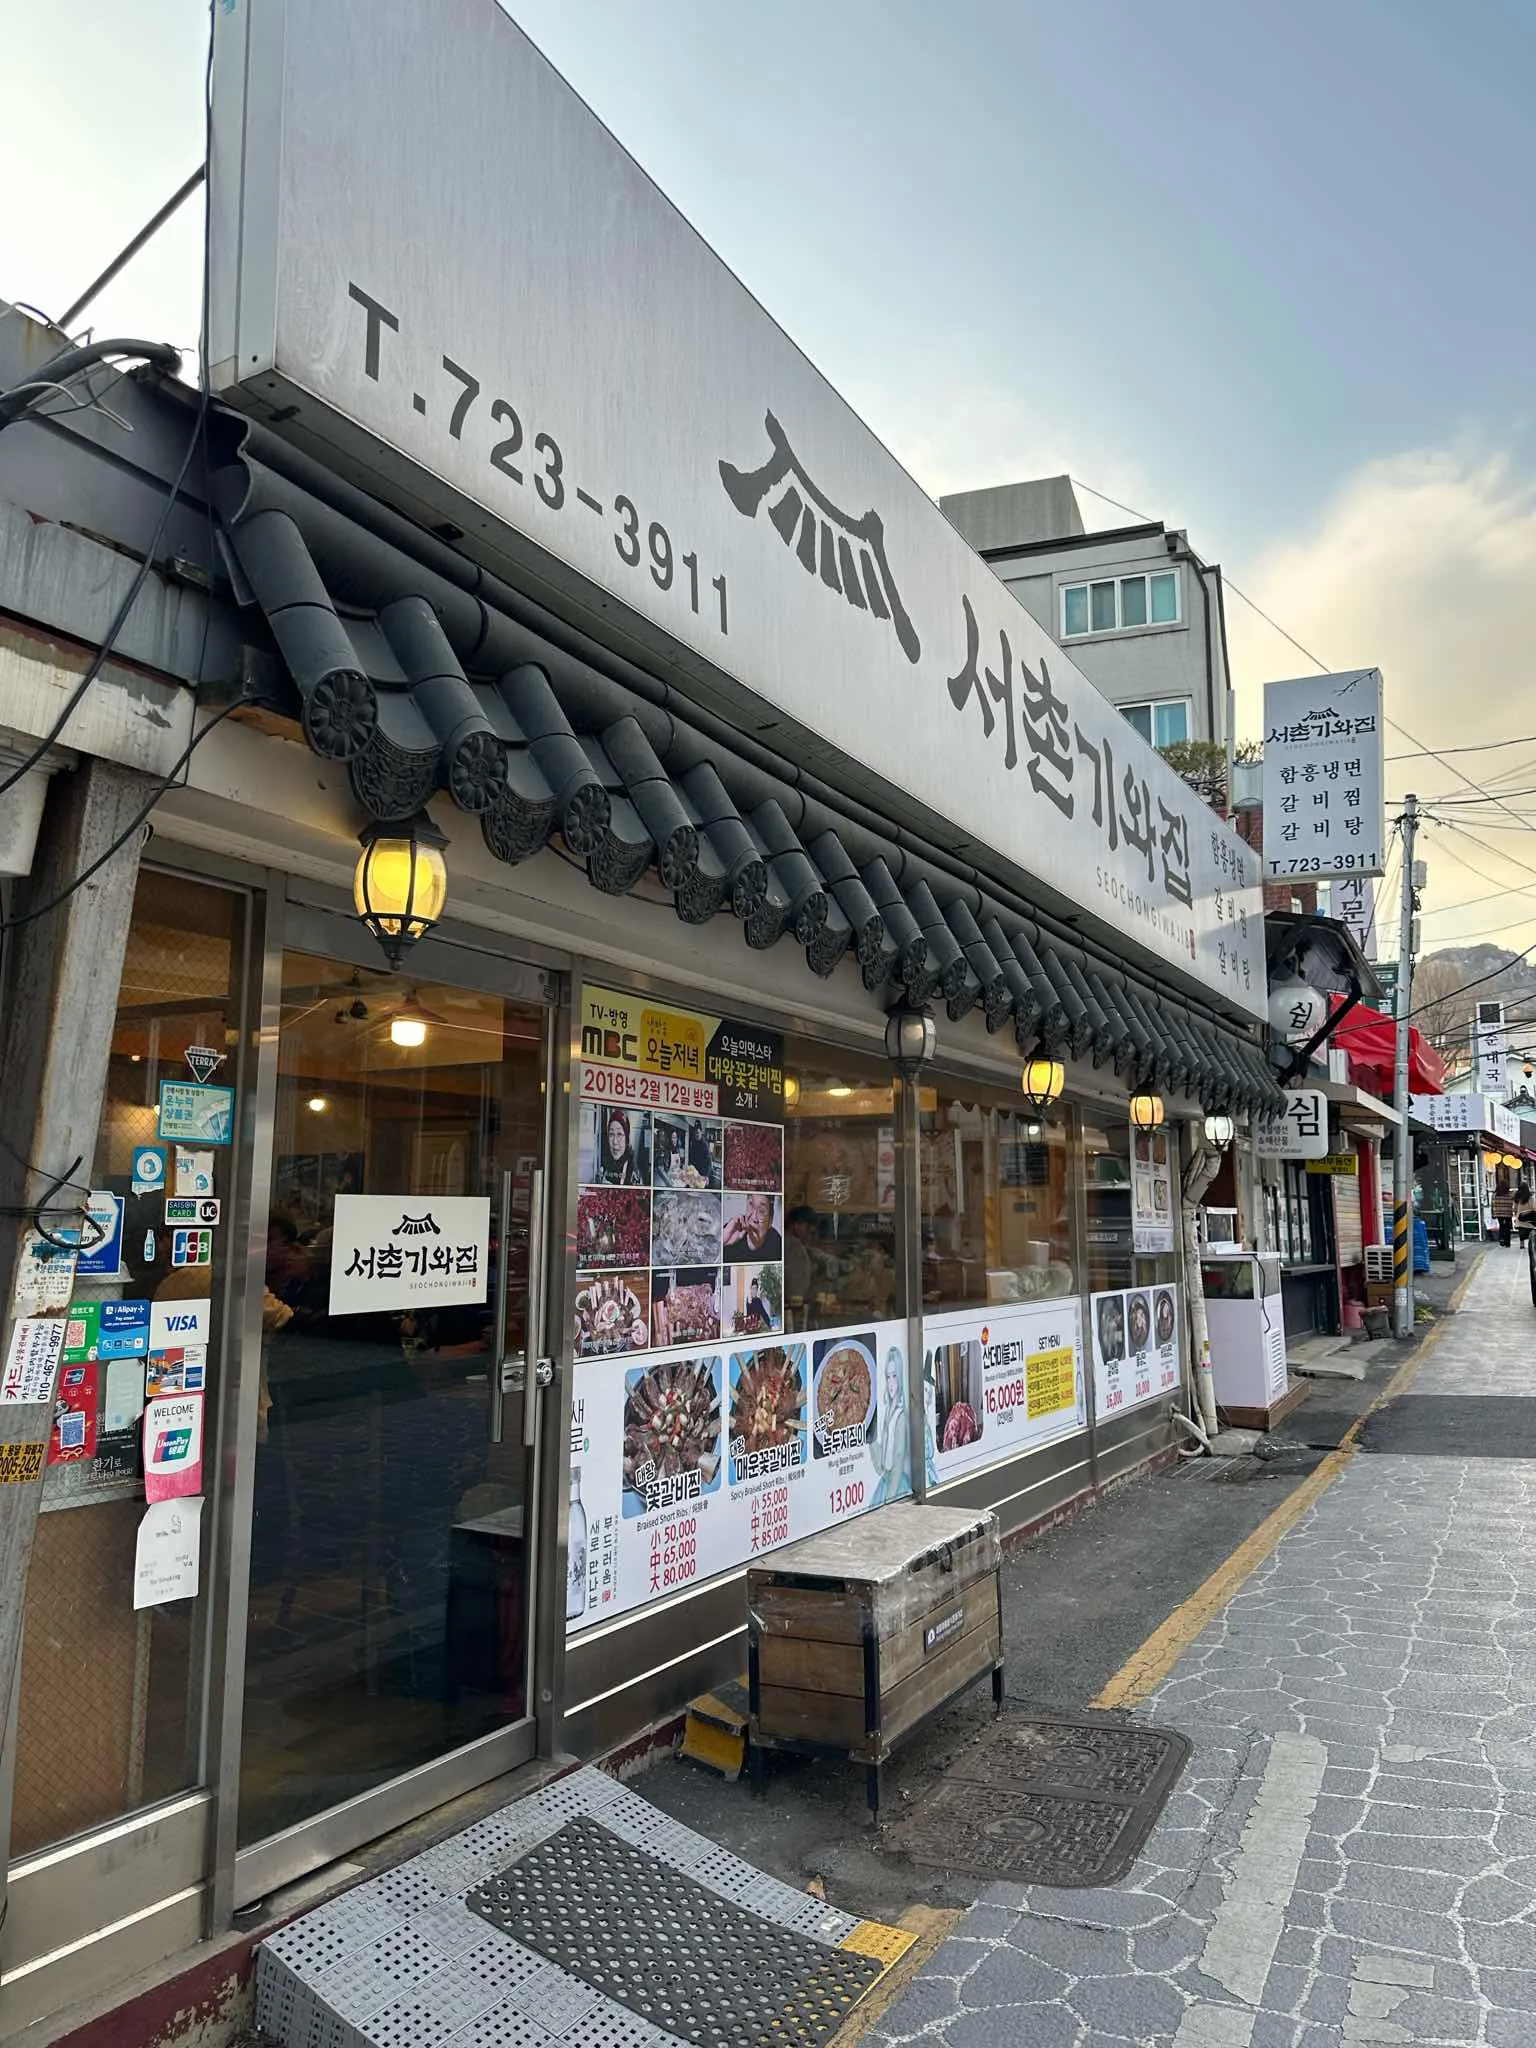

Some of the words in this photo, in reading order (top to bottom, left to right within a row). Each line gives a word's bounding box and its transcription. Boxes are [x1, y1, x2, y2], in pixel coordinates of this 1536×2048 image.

[348, 281, 730, 636] T.723-3911
[1266, 715, 1377, 744] 서촌기와집
[947, 593, 1193, 909] 서촌기와집
[1280, 758, 1362, 785] 함흥냉면
[1211, 831, 1245, 888] 함흥냉면
[1269, 853, 1377, 875] T.723-3911
[590, 1003, 628, 1029] TV-방영
[1289, 1002, 1313, 1029] 쉼
[581, 1025, 638, 1062] MBC
[646, 1038, 700, 1074] 오늘저녁
[190, 1055, 215, 1067] TERRA
[584, 1069, 637, 1098] 2018년
[639, 1078, 661, 1102] 2월
[664, 1081, 691, 1106] 12일
[693, 1087, 714, 1109] 방영
[735, 1091, 758, 1109] 소개!
[1287, 1096, 1320, 1137] 쉼
[169, 1201, 196, 1209] SAISON
[172, 1209, 192, 1217] CARD
[201, 1206, 217, 1217] UC
[175, 1242, 208, 1253] JCB
[344, 1243, 478, 1280] 서촌기와집
[164, 1315, 198, 1332] VISA
[1039, 1336, 1048, 1350] SET
[1048, 1334, 1061, 1348] MENU
[37, 1323, 63, 1401] 010-4671-9977
[5, 1365, 23, 1400] 카드
[984, 1379, 1025, 1414] 16,000원
[154, 1404, 195, 1418] WELCOME
[157, 1436, 189, 1448] UnionPay
[636, 1461, 655, 1484] 대왕
[736, 1441, 801, 1481] 매운꽃갈비찜
[647, 1470, 701, 1513] 꽃갈비찜
[730, 1490, 744, 1502] Spicy
[762, 1479, 775, 1491] Short
[751, 1495, 760, 1514] 小
[761, 1487, 788, 1510] 55,000
[829, 1481, 865, 1515] 13,000
[637, 1518, 659, 1532] Braised
[660, 1512, 676, 1524] Short
[650, 1530, 661, 1550] 小
[664, 1518, 696, 1545] 50,000
[751, 1513, 760, 1534] 中
[761, 1505, 788, 1528] 70,000
[751, 1533, 760, 1553] 大
[761, 1523, 788, 1548] 85,000
[650, 1551, 661, 1572] 中
[663, 1538, 696, 1566] 65,000
[650, 1572, 661, 1593] 大
[663, 1558, 696, 1587] 80,000
